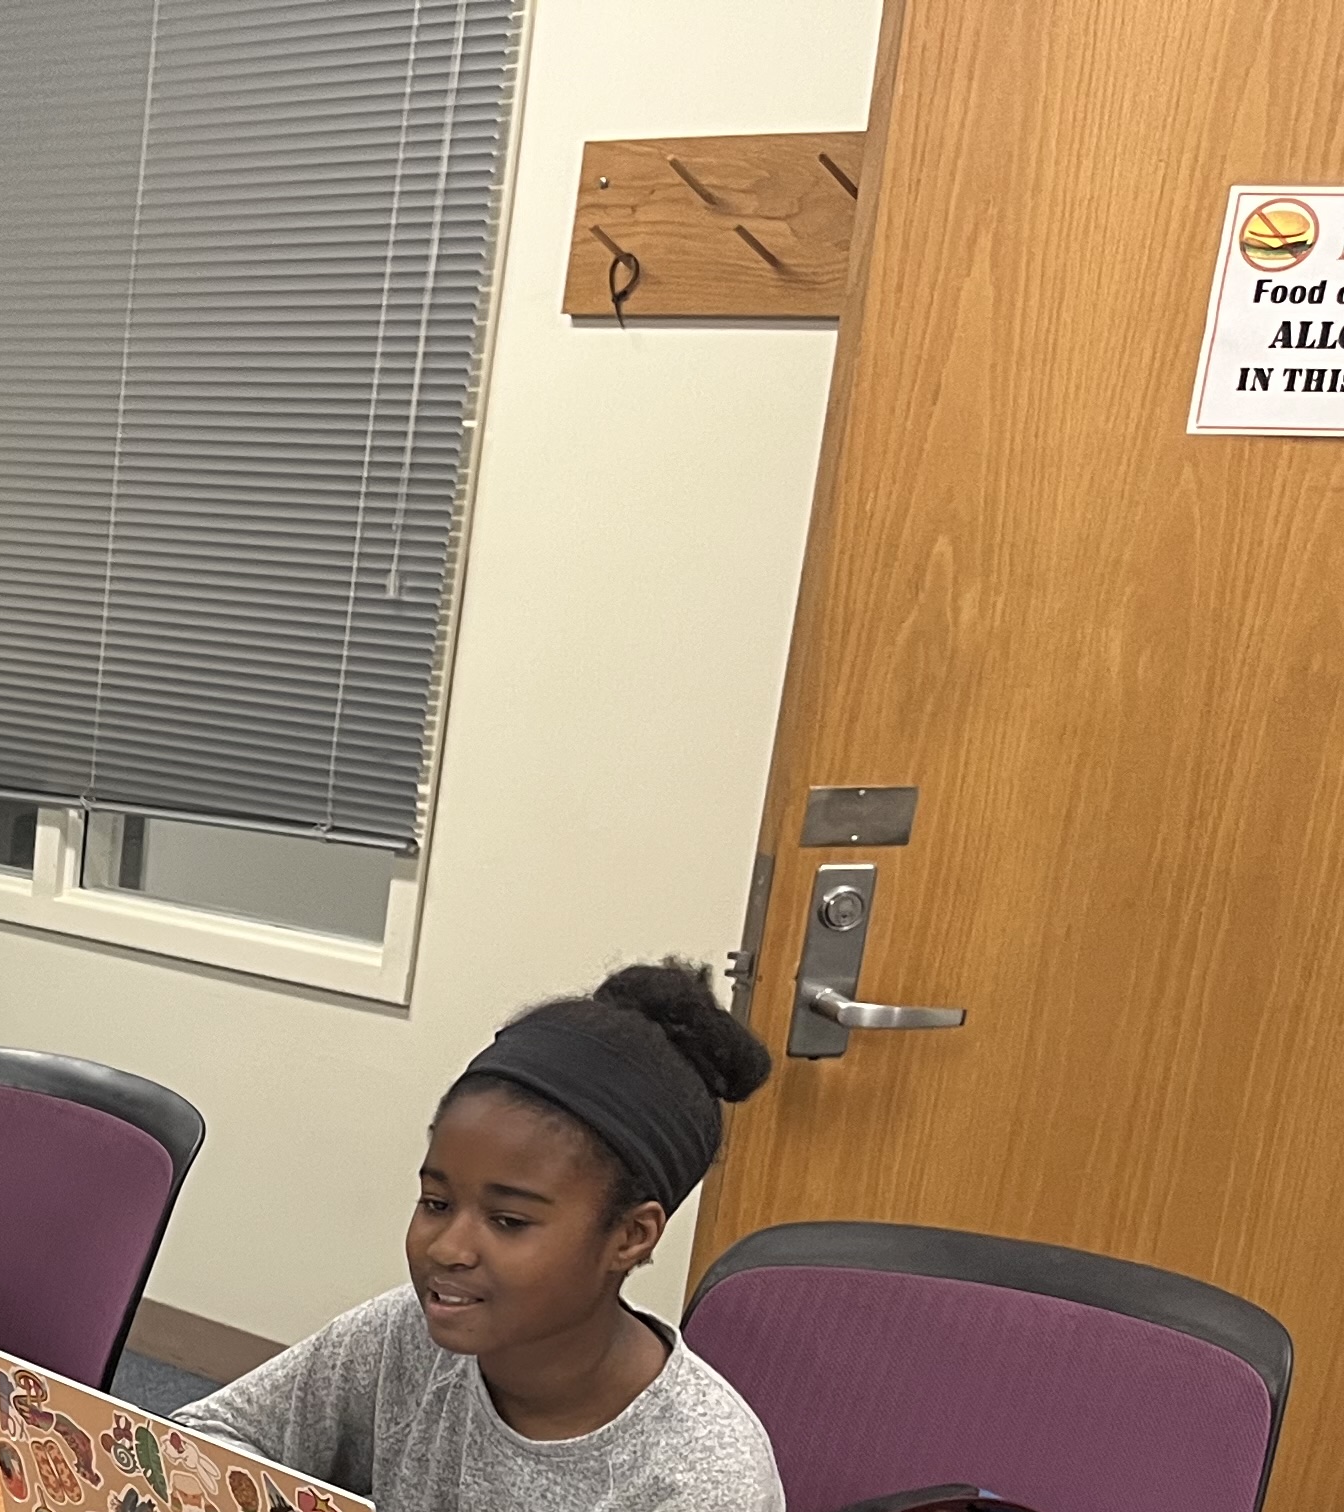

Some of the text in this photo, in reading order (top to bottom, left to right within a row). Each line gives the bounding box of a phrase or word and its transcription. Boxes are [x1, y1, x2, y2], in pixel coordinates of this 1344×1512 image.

[1253, 279, 1327, 304] Food
[1236, 367, 1344, 392] IN THI
